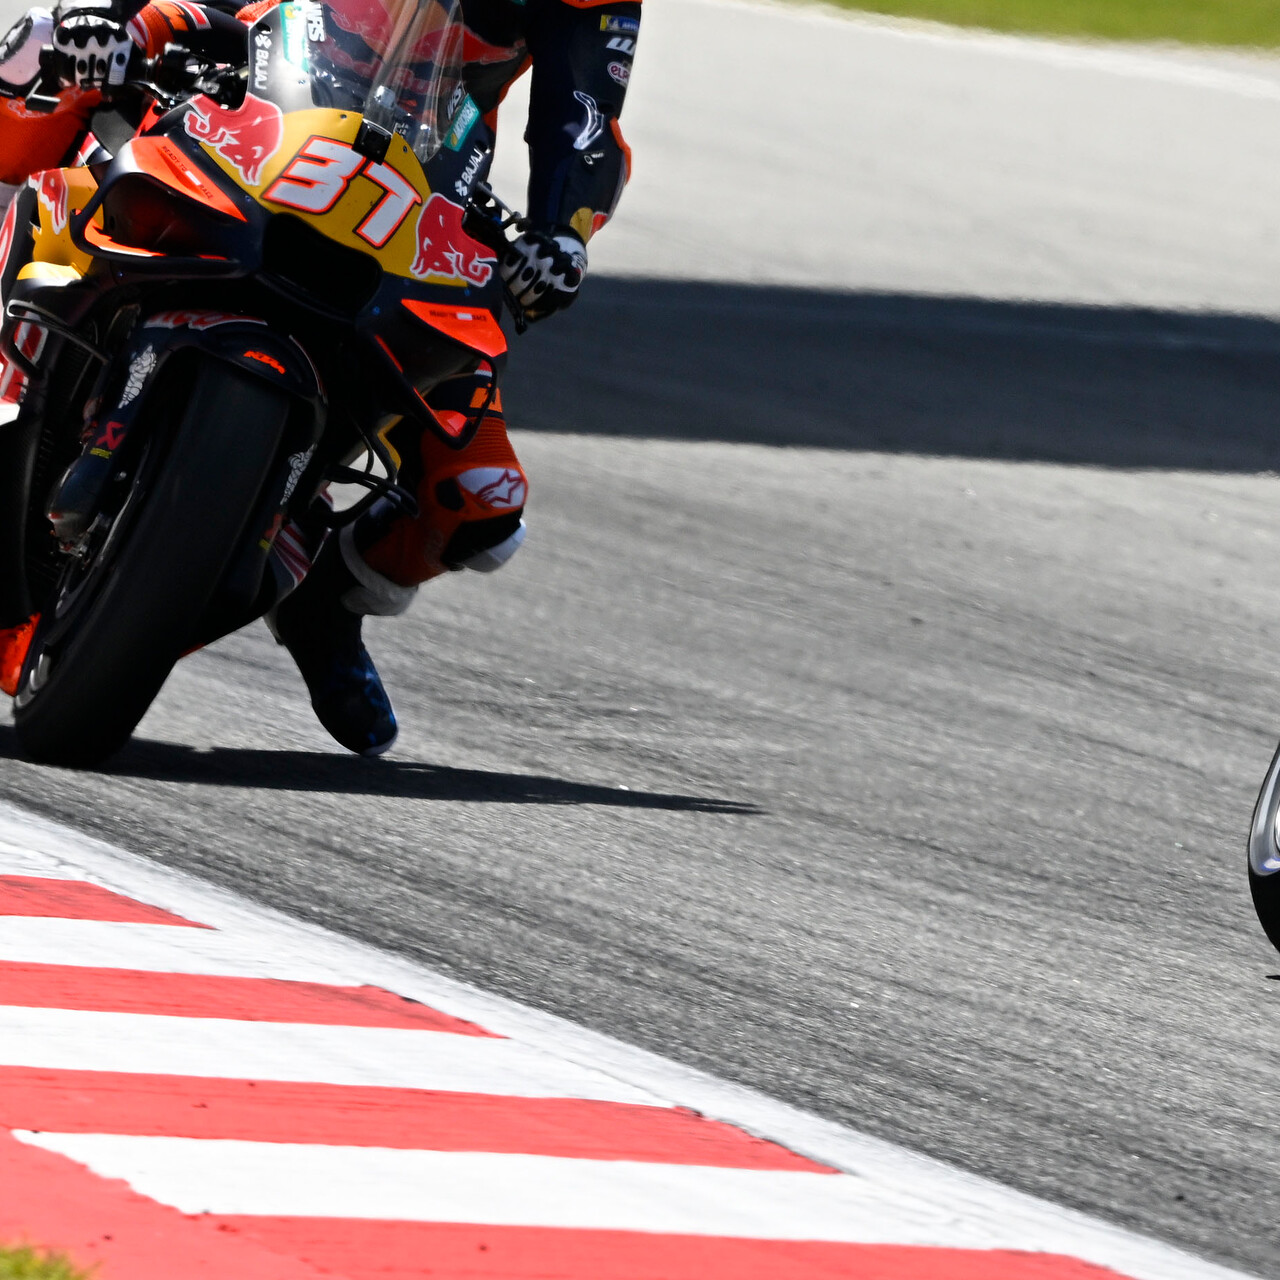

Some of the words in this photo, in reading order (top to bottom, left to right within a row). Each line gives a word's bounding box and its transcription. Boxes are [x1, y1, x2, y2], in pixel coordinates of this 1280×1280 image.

[254, 46, 269, 91] BAJAJ
[161, 145, 180, 167] READY
[462, 147, 484, 182] BAJAJ
[261, 135, 423, 250] 37
[243, 349, 287, 375] KTM
